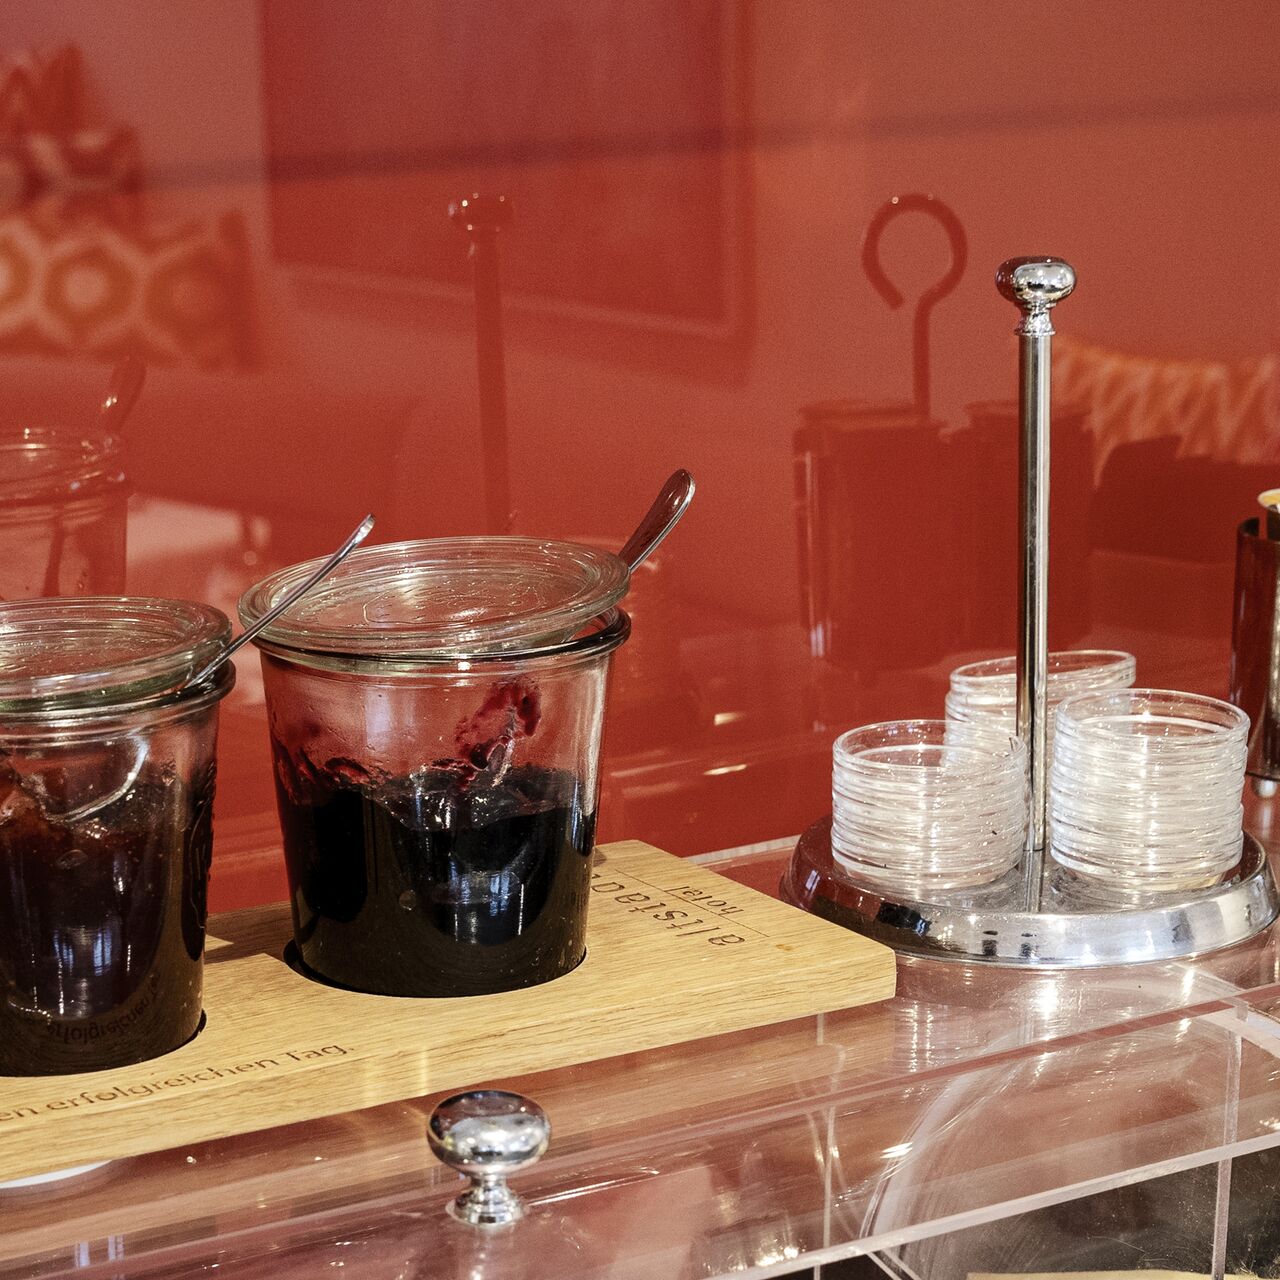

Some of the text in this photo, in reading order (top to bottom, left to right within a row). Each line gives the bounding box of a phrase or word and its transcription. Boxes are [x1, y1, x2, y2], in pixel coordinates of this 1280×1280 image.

[665, 885, 745, 916] hotel
[46, 1058, 279, 1110] erfolgreichen
[281, 1044, 354, 1062] Tag.
